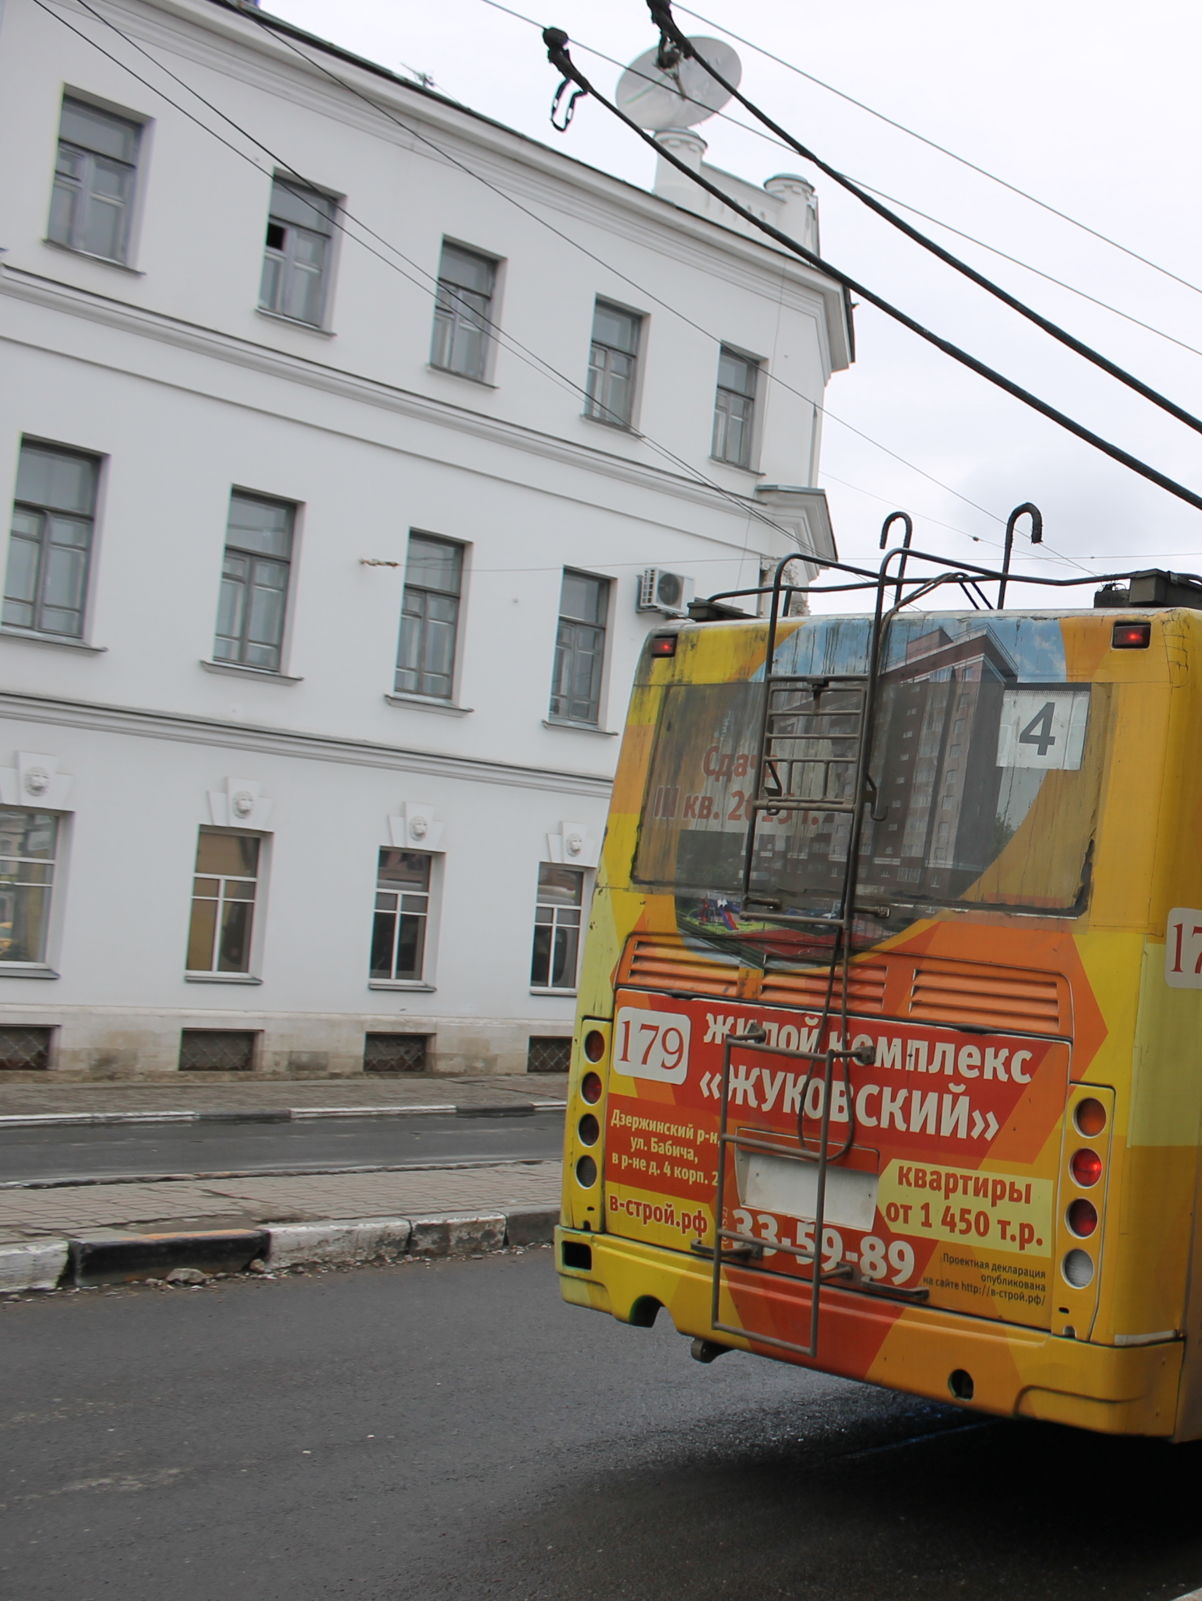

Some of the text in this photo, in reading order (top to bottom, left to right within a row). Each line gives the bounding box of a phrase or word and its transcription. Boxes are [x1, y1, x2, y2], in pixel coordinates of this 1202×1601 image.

[1019, 702, 1056, 756] 4
[682, 795, 720, 821] кв.
[618, 1020, 684, 1070] 179
[699, 1064, 1000, 1142] «ЖУКОВСКИЙ»
[611, 1109, 694, 1140] Дзержинский
[612, 1152, 720, 1187] в р-не д. 4 корп. 2
[630, 1136, 698, 1164] ул. Бабича,
[898, 1165, 1033, 1208] квартиры
[609, 1194, 709, 1239] в-строй.рф
[886, 1201, 1043, 1252] от 1 450 т.р.
[732, 1208, 915, 1286] 33-59-89
[943, 1253, 1046, 1279] Проектная декларация
[935, 1276, 960, 1290] сайте
[980, 1273, 1046, 1292] опубликована
